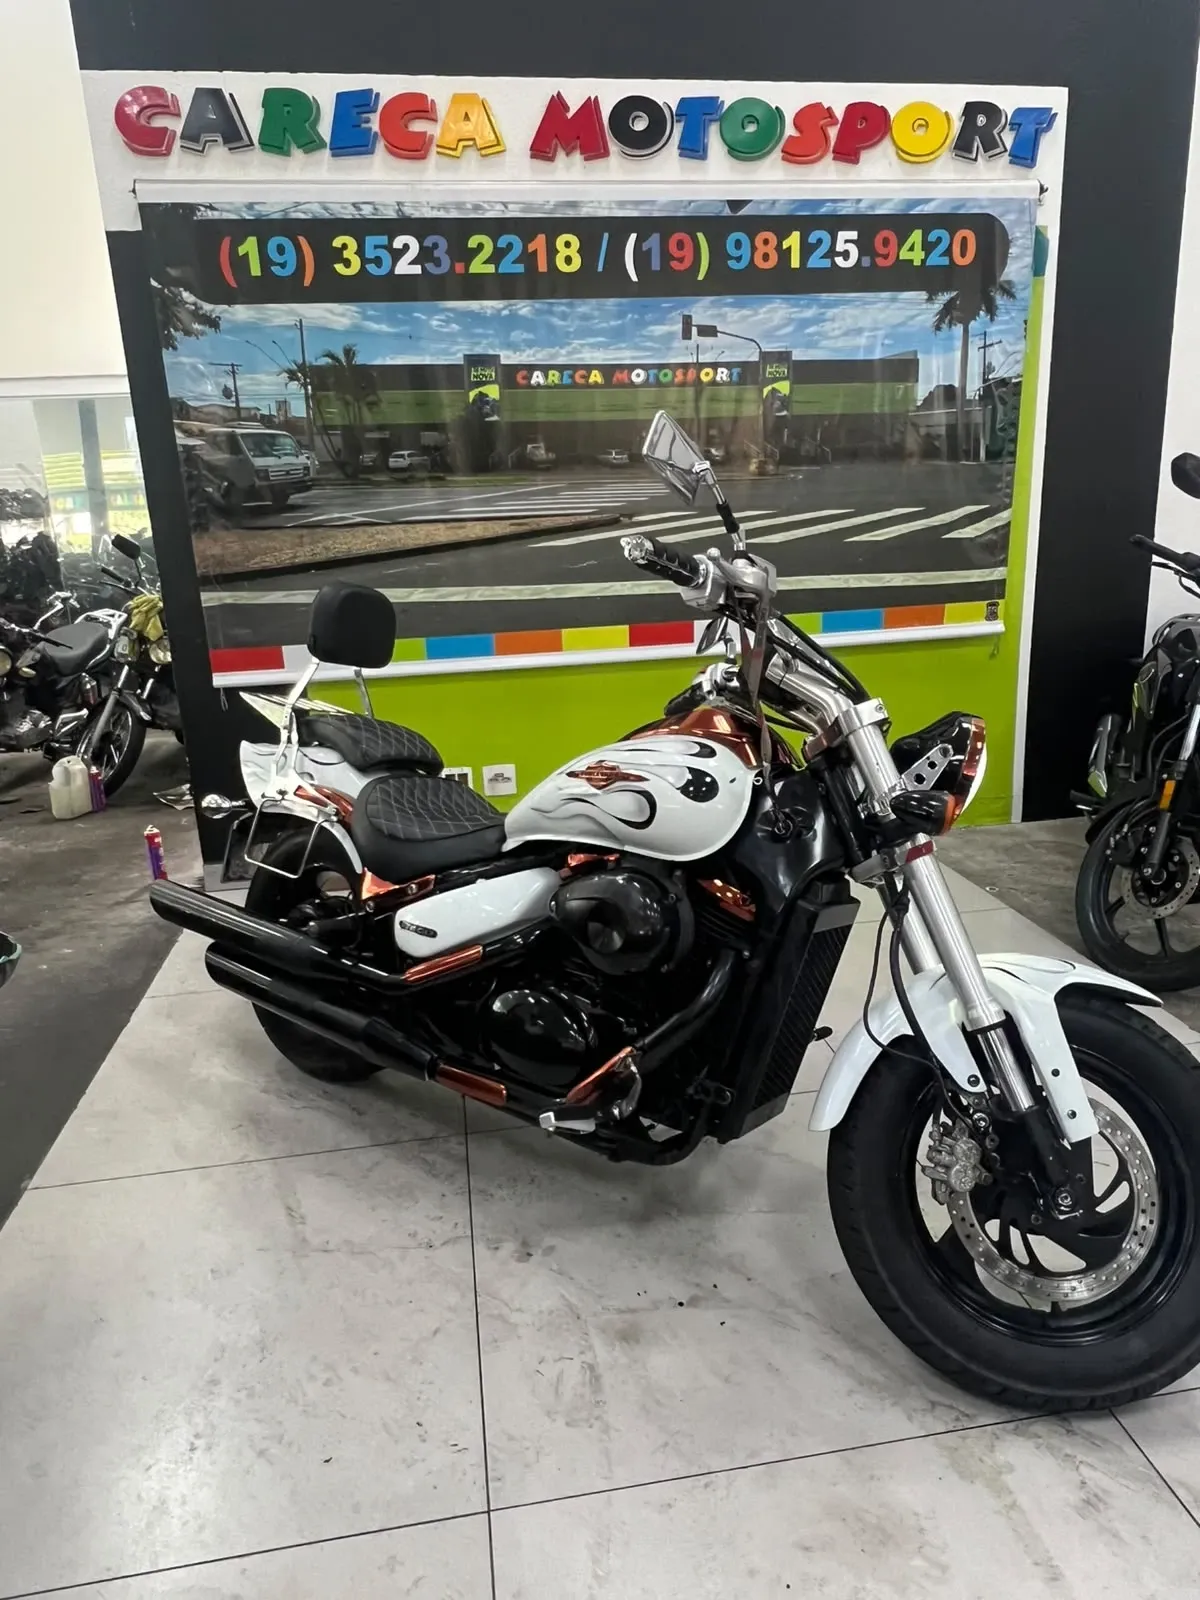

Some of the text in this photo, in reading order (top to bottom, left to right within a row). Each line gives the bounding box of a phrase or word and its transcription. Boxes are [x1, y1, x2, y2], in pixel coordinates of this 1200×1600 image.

[114, 85, 1058, 168] CARECA MOTOSPORT
[219, 236, 315, 287] (19)
[332, 234, 582, 276] 3523.2218
[625, 232, 710, 282] (19)
[726, 229, 977, 270] 98125.9420
[515, 369, 605, 386] CARECA
[613, 368, 742, 385] MOTOSPORT
